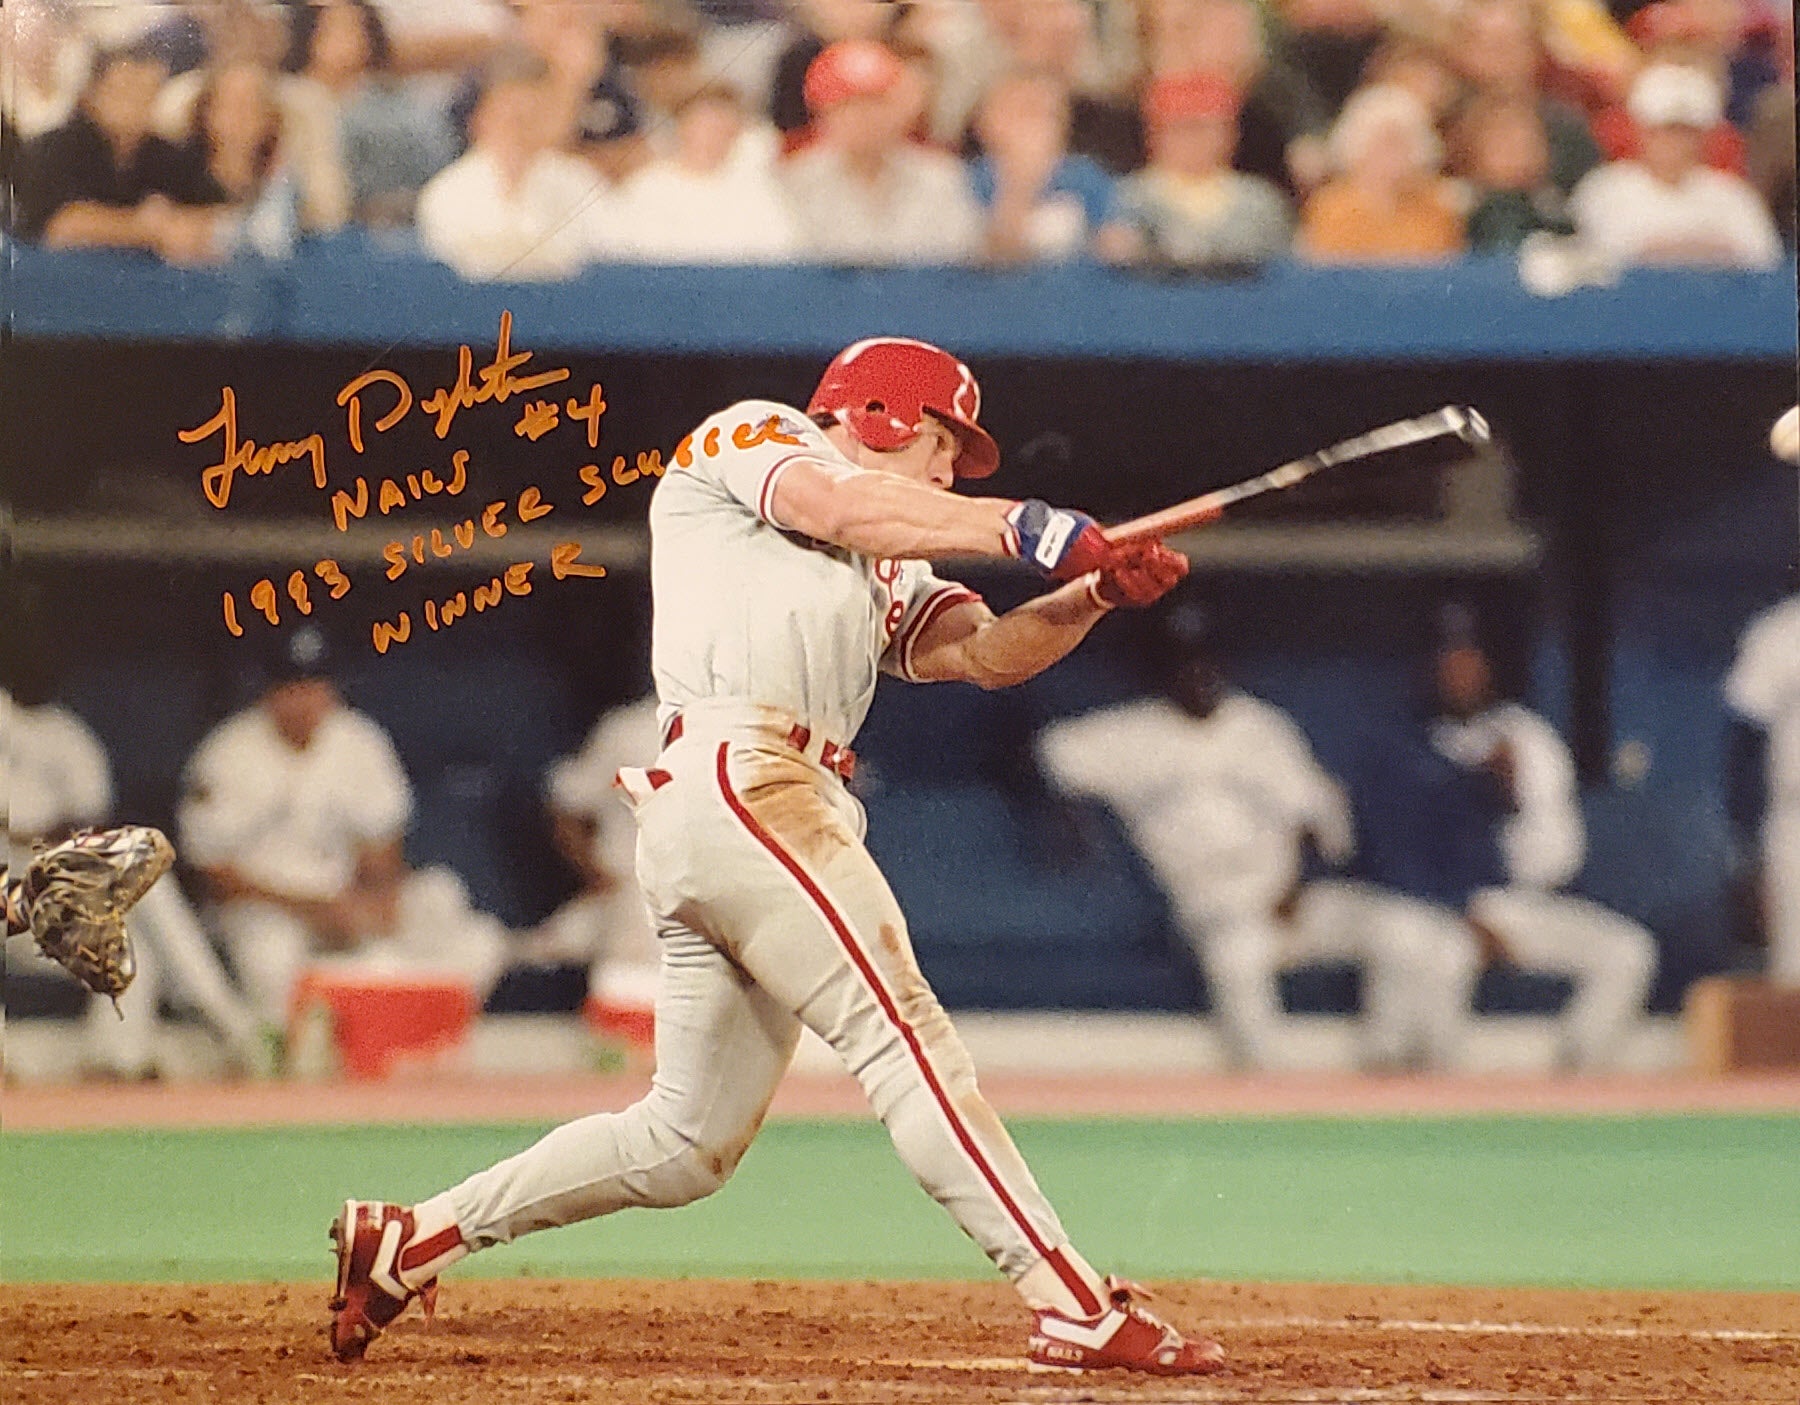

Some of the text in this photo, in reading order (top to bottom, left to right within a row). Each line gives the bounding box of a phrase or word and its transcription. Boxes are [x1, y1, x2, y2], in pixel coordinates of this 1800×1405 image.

[514, 383, 607, 448] #4
[331, 449, 470, 532] NAILS
[223, 558, 351, 637] 1993
[382, 486, 554, 581] SILVER
[372, 539, 607, 655] WINNER
